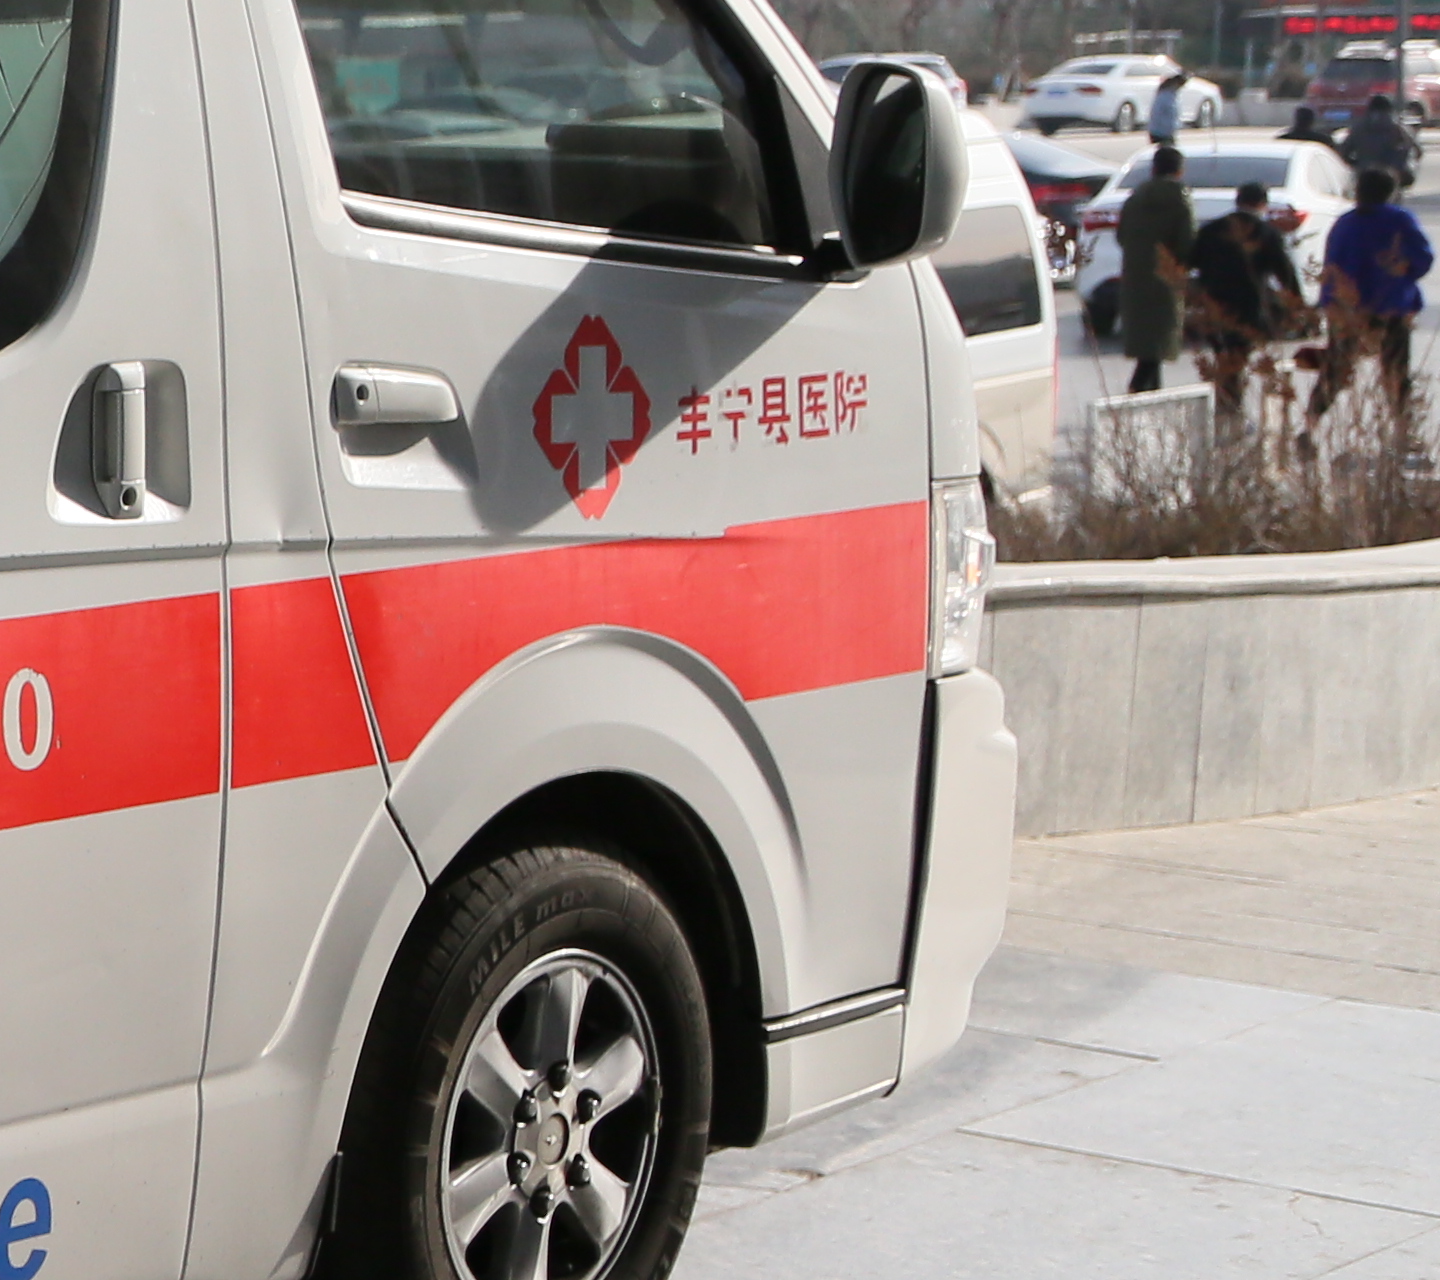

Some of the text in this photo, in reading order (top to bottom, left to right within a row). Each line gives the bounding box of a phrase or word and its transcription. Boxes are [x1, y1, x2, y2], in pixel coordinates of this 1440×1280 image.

[676, 370, 868, 457] 丰宁县医院
